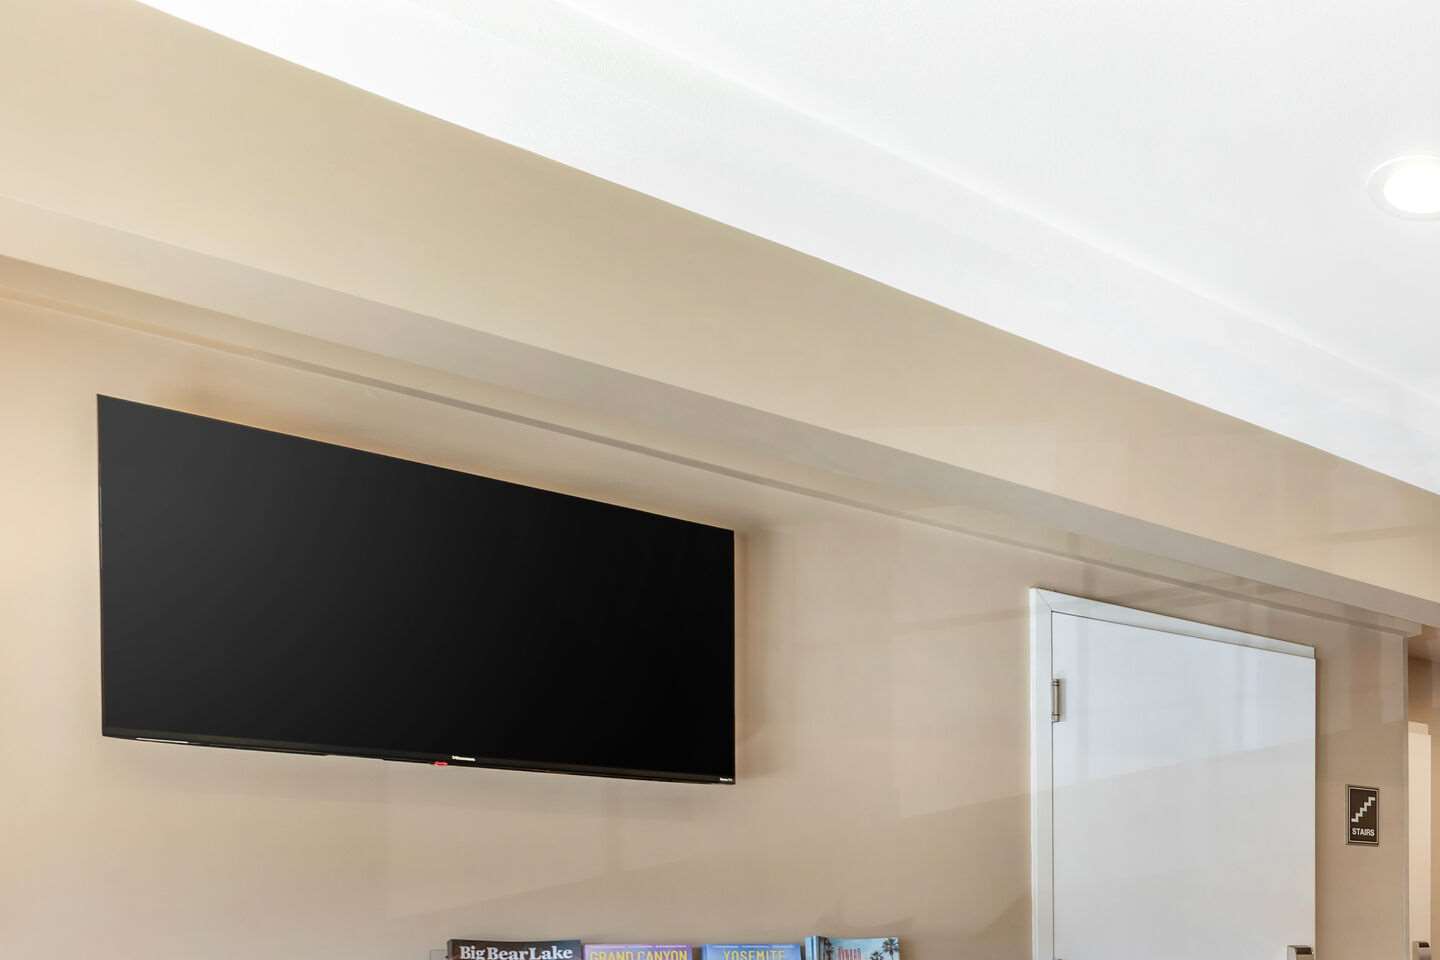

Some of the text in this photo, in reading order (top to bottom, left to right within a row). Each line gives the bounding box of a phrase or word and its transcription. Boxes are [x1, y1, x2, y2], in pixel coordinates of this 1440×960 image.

[1352, 828, 1375, 837] STAIRS
[487, 947, 529, 960] Bear
[529, 946, 573, 960] Lake
